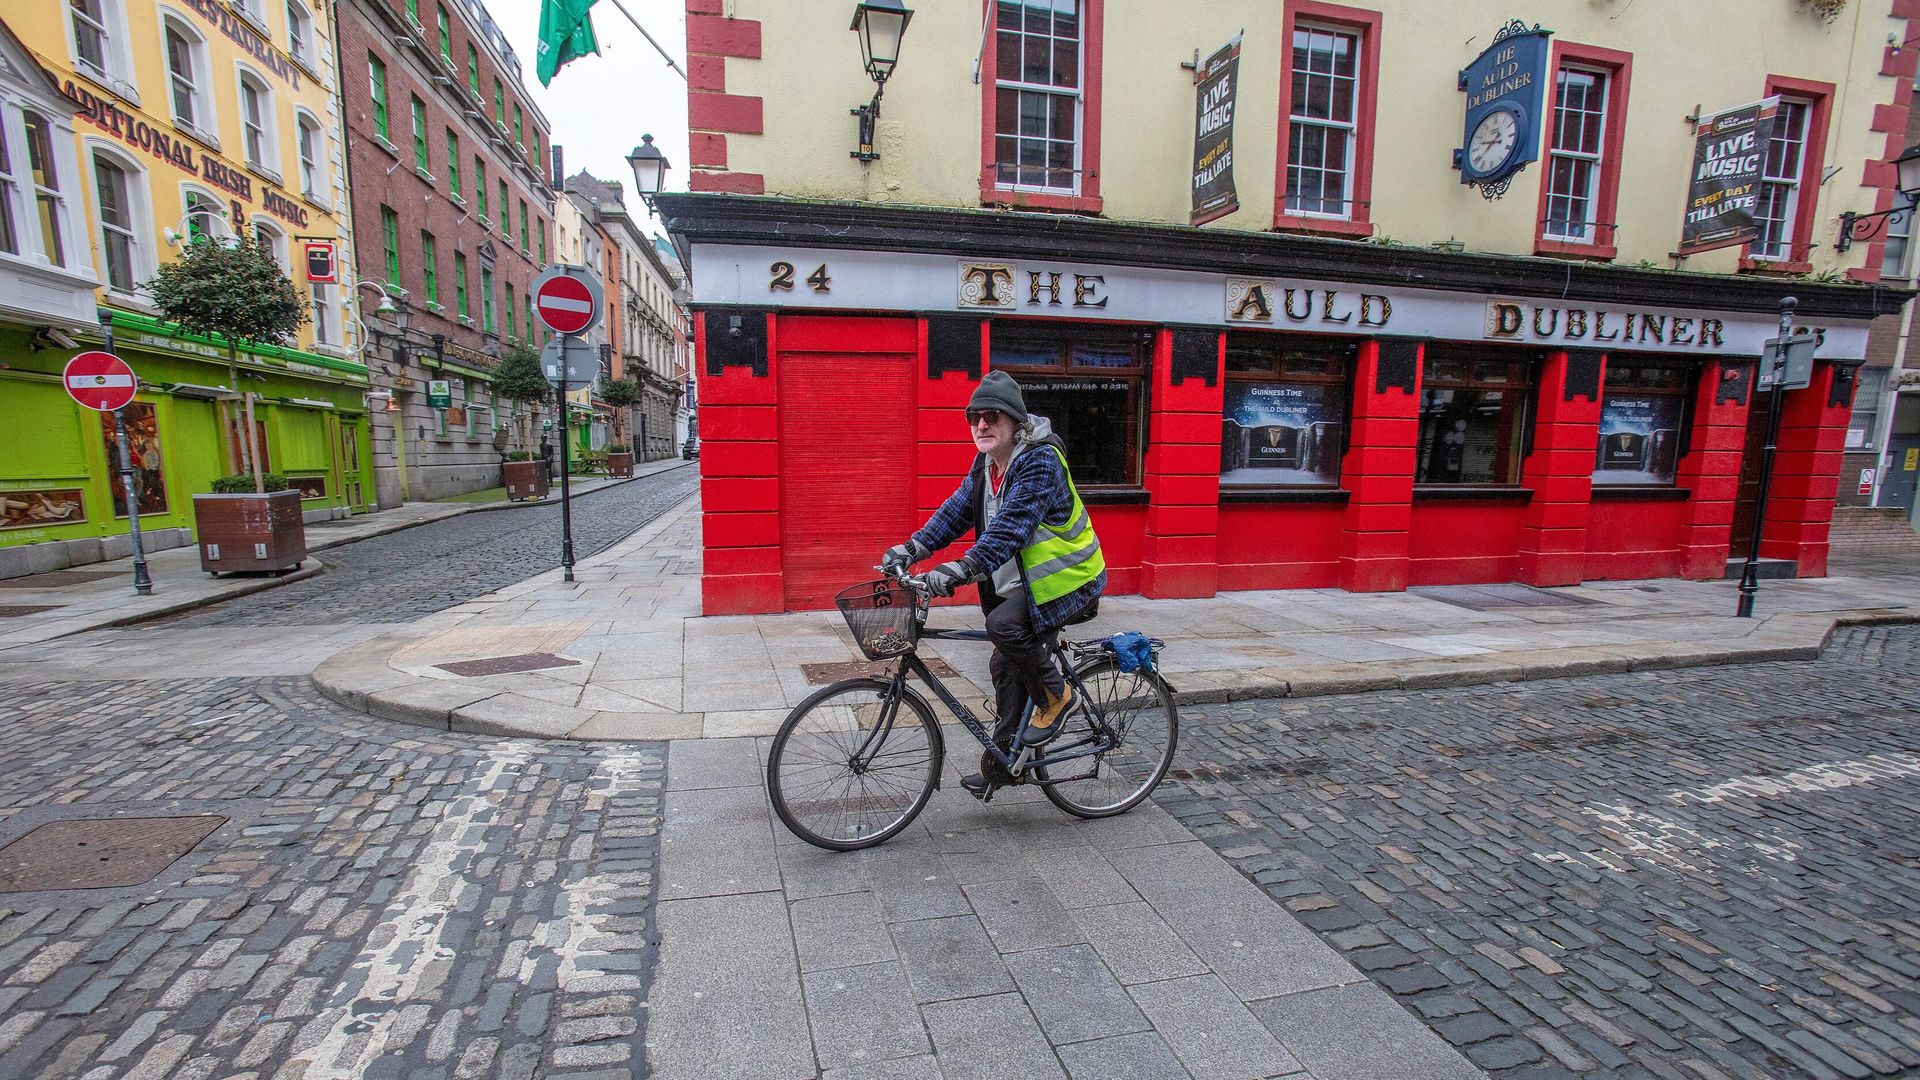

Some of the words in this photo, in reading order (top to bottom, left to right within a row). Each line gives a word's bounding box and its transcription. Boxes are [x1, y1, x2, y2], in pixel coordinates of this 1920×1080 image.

[181, 0, 300, 92] ESTAURANT
[1490, 46, 1516, 66] HE
[1468, 72, 1532, 110] DUBLINER
[1482, 62, 1518, 88] AULD
[1204, 73, 1230, 114] LIVE
[43, 68, 198, 178] ADITIONAL
[1200, 100, 1232, 137] MUSIC
[1199, 147, 1216, 170] EVERY
[1216, 137, 1229, 156] DAY
[1706, 130, 1756, 162] LIVE
[1194, 167, 1214, 189] TILL
[1213, 151, 1232, 178] LATE
[1697, 153, 1760, 181] MUSIC
[200, 153, 252, 203] IRISH
[262, 186, 308, 229] MUSIC
[1695, 190, 1723, 207] EVERY
[1725, 183, 1753, 197] DAY
[1687, 206, 1718, 223] TILL
[1718, 195, 1755, 215] LATE
[768, 260, 831, 294] 24
[966, 264, 1110, 308] THE
[1231, 283, 1393, 327] AULD
[1493, 301, 1725, 346] DUBLINER
[1251, 387, 1285, 397] GUINNESS
[1286, 389, 1302, 397] TIME
[1610, 400, 1636, 408] GUINNESS
[1276, 406, 1308, 414] DUBLINER
[1261, 446, 1287, 454] GUINNESS
[950, 702, 1000, 752] GIANT
